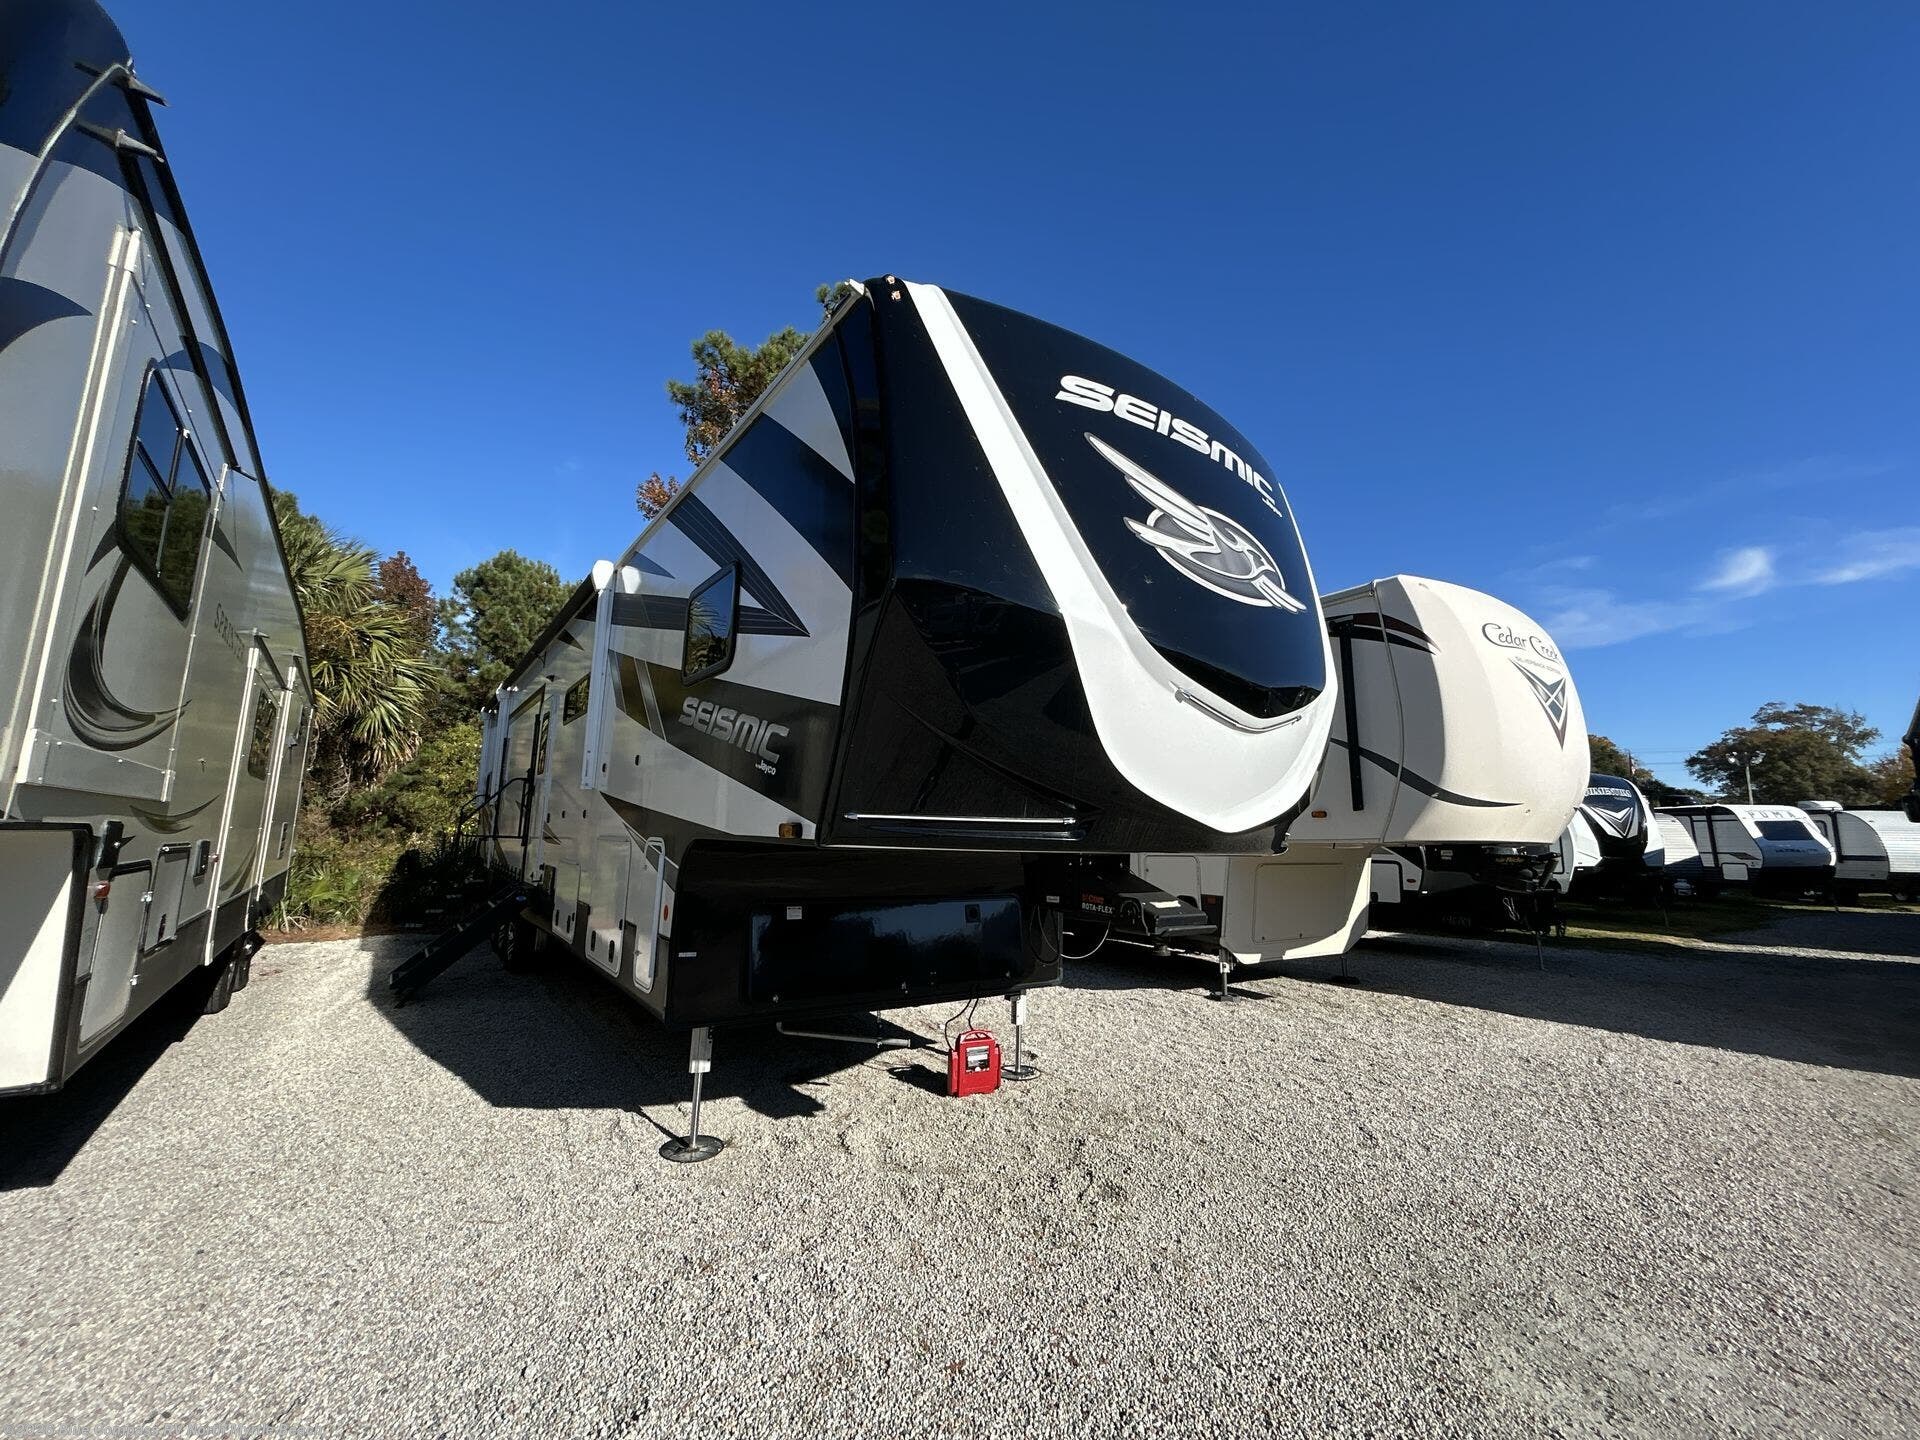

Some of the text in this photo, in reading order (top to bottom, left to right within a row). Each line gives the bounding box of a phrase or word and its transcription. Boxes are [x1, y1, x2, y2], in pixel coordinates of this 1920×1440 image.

[1055, 375, 1276, 505] SEISMIC
[1481, 622, 1562, 664] Cedar Creek
[678, 696, 790, 764] SEISMIC
